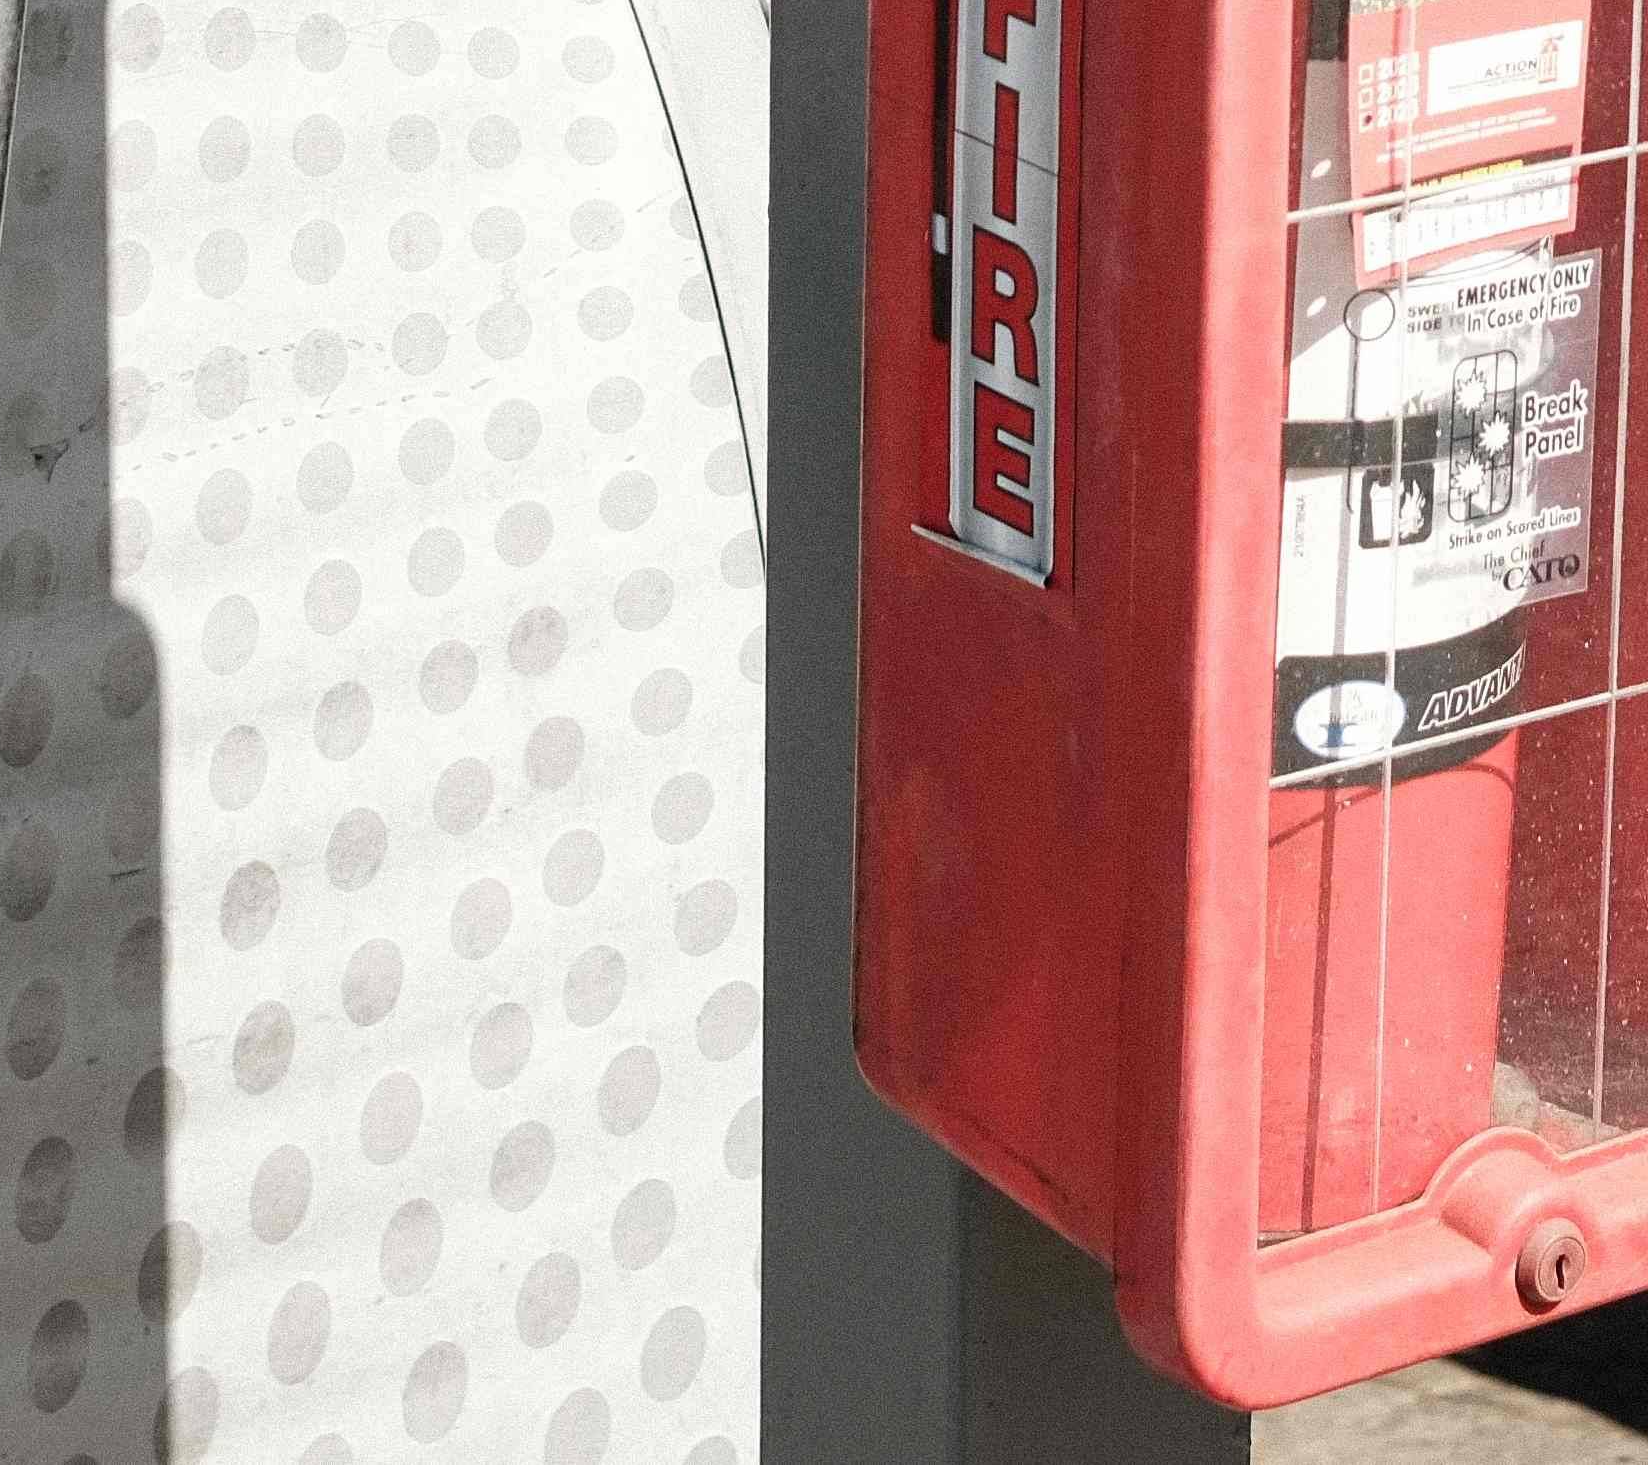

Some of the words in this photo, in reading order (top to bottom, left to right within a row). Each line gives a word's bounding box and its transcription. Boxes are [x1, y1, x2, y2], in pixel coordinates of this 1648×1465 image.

[1456, 271, 1548, 309] EMERGENCY
[1552, 263, 1591, 289] ONLY
[1467, 312, 1481, 332] In
[1487, 308, 1523, 329] Case
[1529, 296, 1546, 320] of
[1551, 296, 1578, 317] Fire
[1525, 384, 1585, 423] Break
[1525, 420, 1582, 456] Panel
[1449, 528, 1482, 549] Strike
[1487, 527, 1502, 541] on
[1507, 513, 1546, 536] Scored
[1551, 508, 1579, 526] Lines
[1483, 552, 1505, 570] The
[1510, 540, 1545, 565] Chief
[1503, 553, 1581, 591] CATO
[1418, 637, 1527, 731] ADVANT
